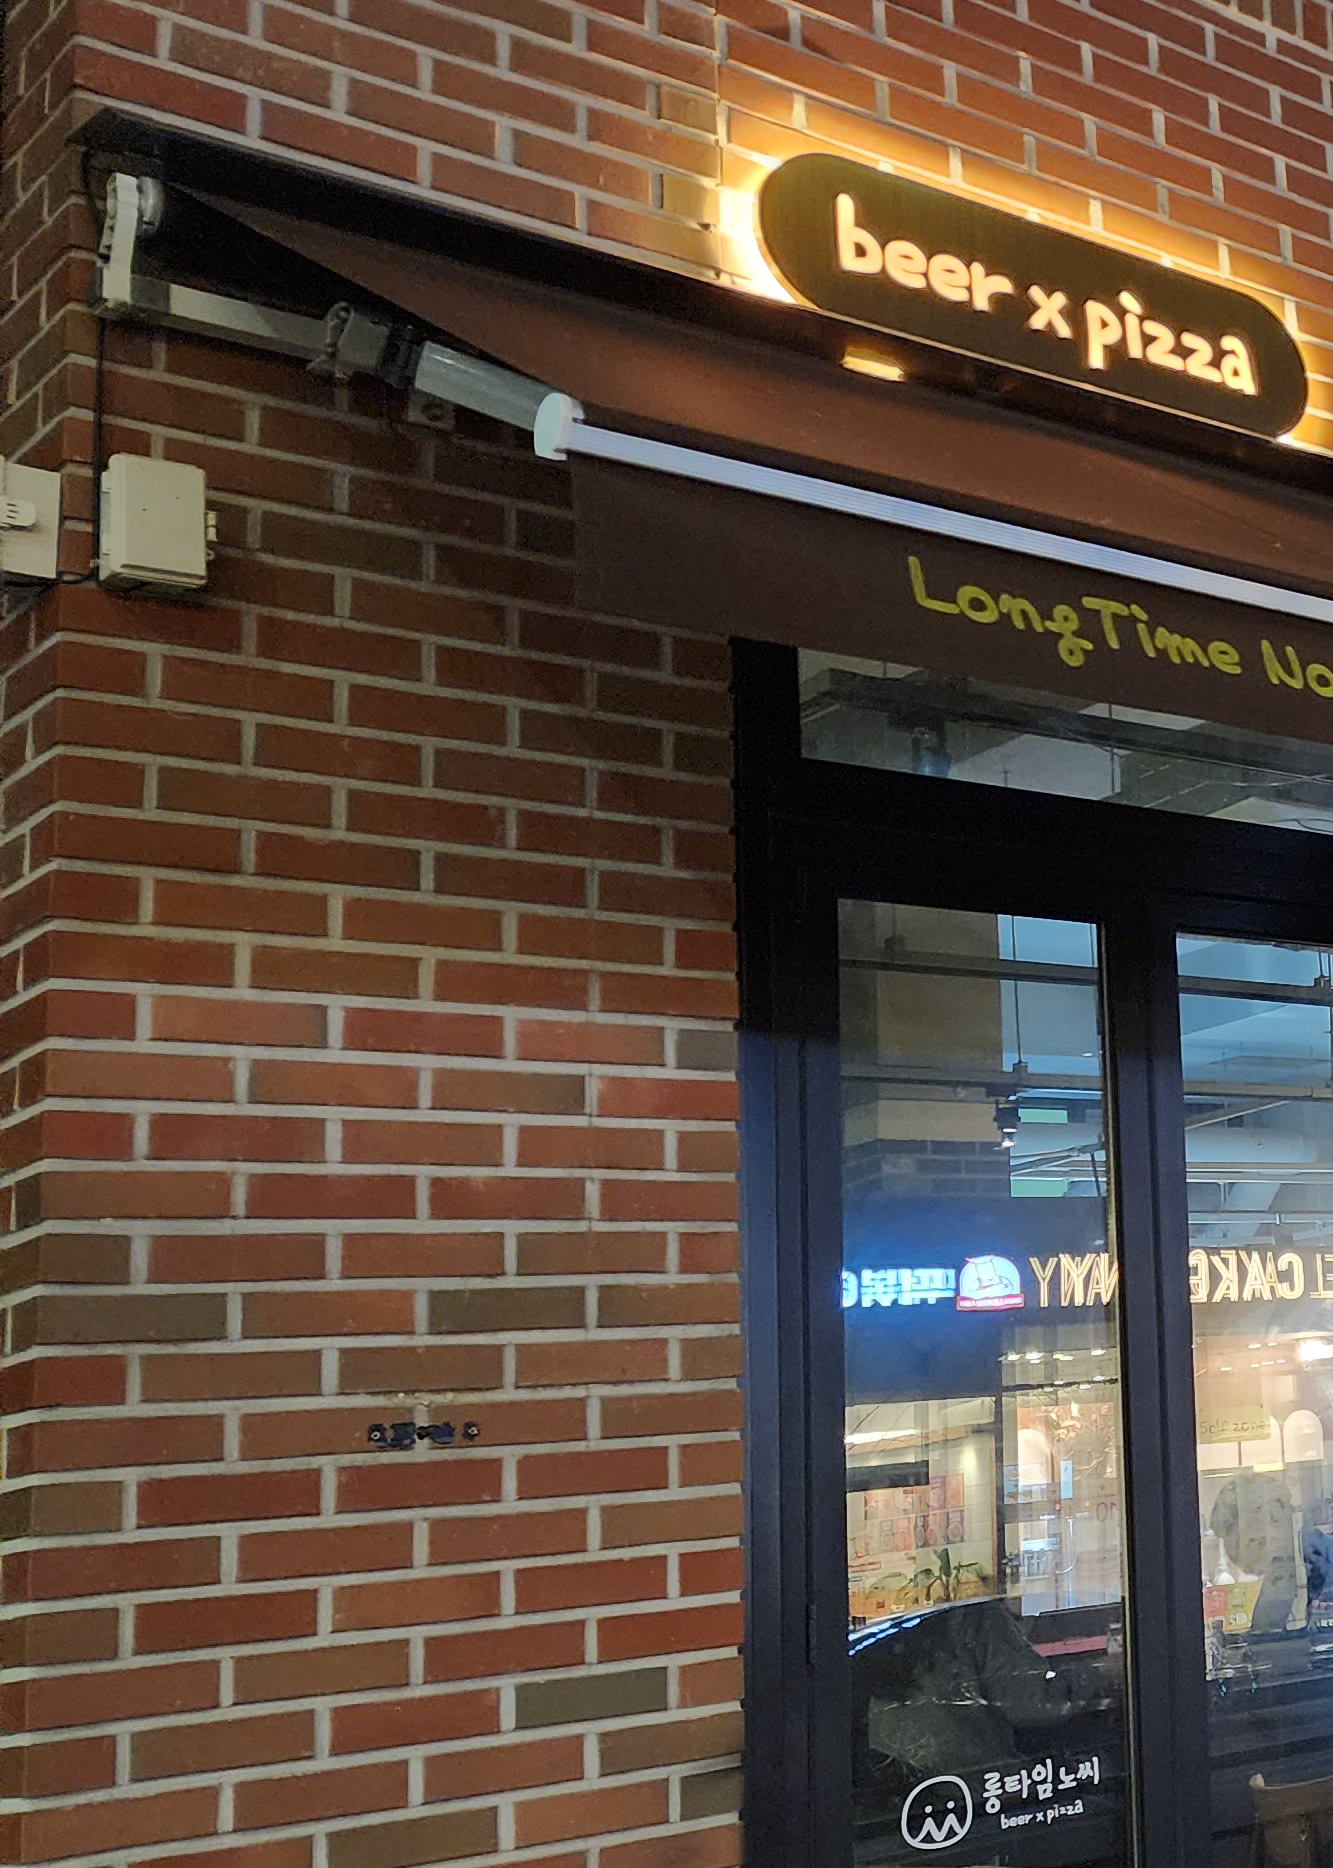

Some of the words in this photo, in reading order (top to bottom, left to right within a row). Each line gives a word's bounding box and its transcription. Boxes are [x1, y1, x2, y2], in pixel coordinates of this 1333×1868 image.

[836, 194, 1012, 311] beer
[1028, 283, 1072, 339] x
[1084, 291, 1258, 395] pizza
[1001, 1812, 1033, 1830] beer
[1035, 1812, 1045, 1823] x
[1046, 1799, 1084, 1825] pizza
